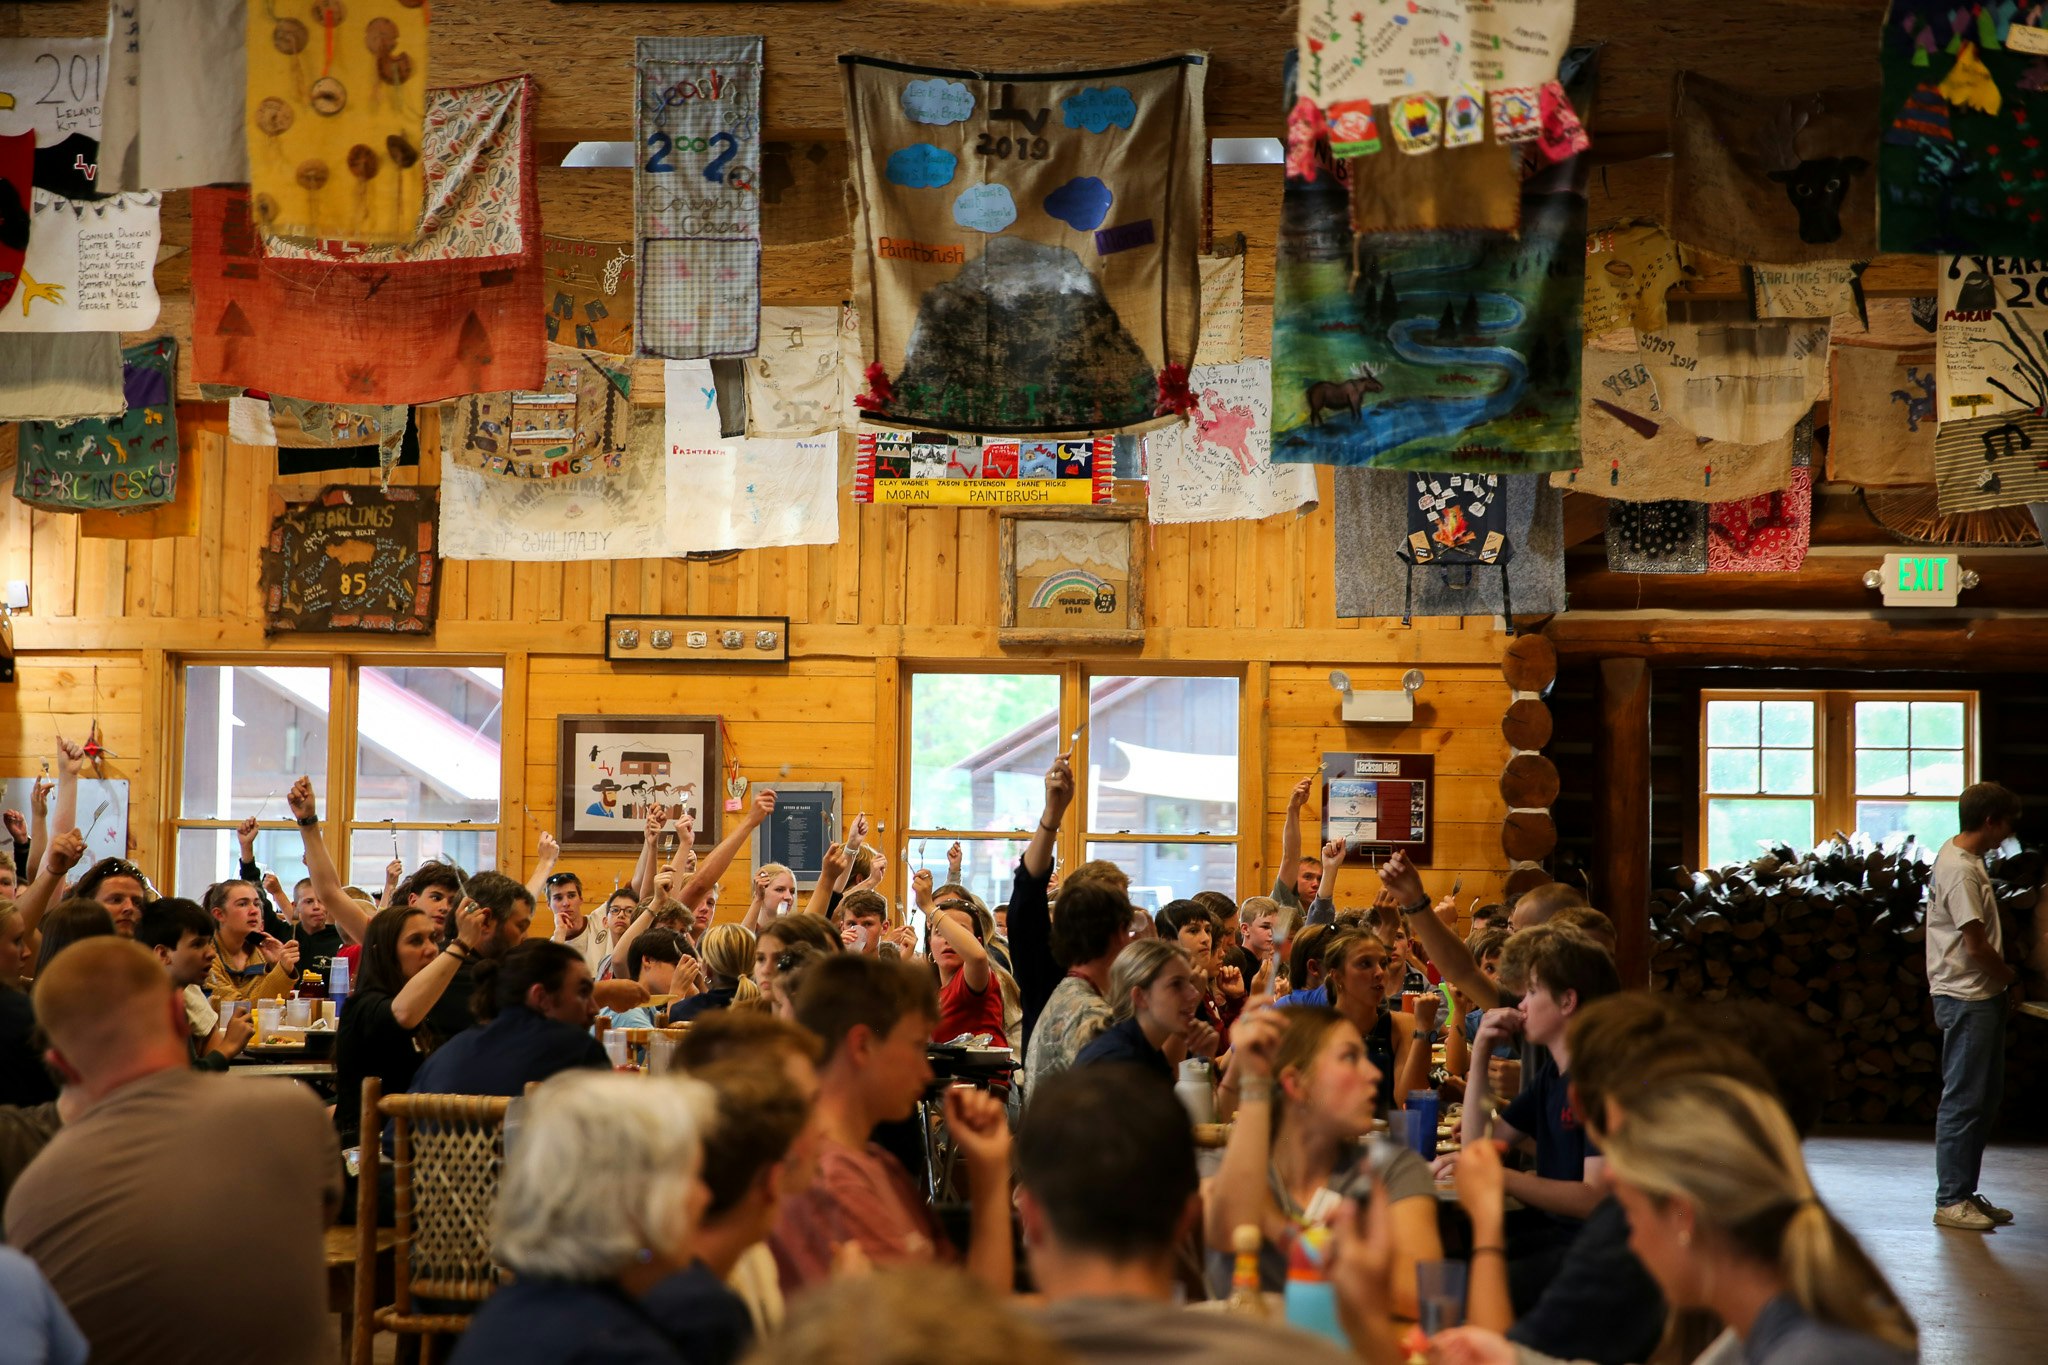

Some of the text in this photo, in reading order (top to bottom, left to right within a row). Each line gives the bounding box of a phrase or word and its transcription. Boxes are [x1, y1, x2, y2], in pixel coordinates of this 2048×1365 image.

[56, 106, 101, 119] LELAND
[976, 132, 1049, 160] 2019
[878, 236, 965, 264] Paintbrush
[1944, 309, 1992, 323] MORAN
[481, 453, 593, 479] YEARLINGS
[22, 460, 146, 501] YEARLINGS
[1017, 480, 1040, 488] SHANE
[1045, 480, 1067, 488] HICKS
[886, 489, 1049, 502] MORAN PAINTBRUSH
[309, 504, 396, 530] YEARLINGS
[340, 573, 366, 595] 85
[1899, 557, 1949, 591] EXIT
[1357, 760, 1398, 773] Jackson Hole
